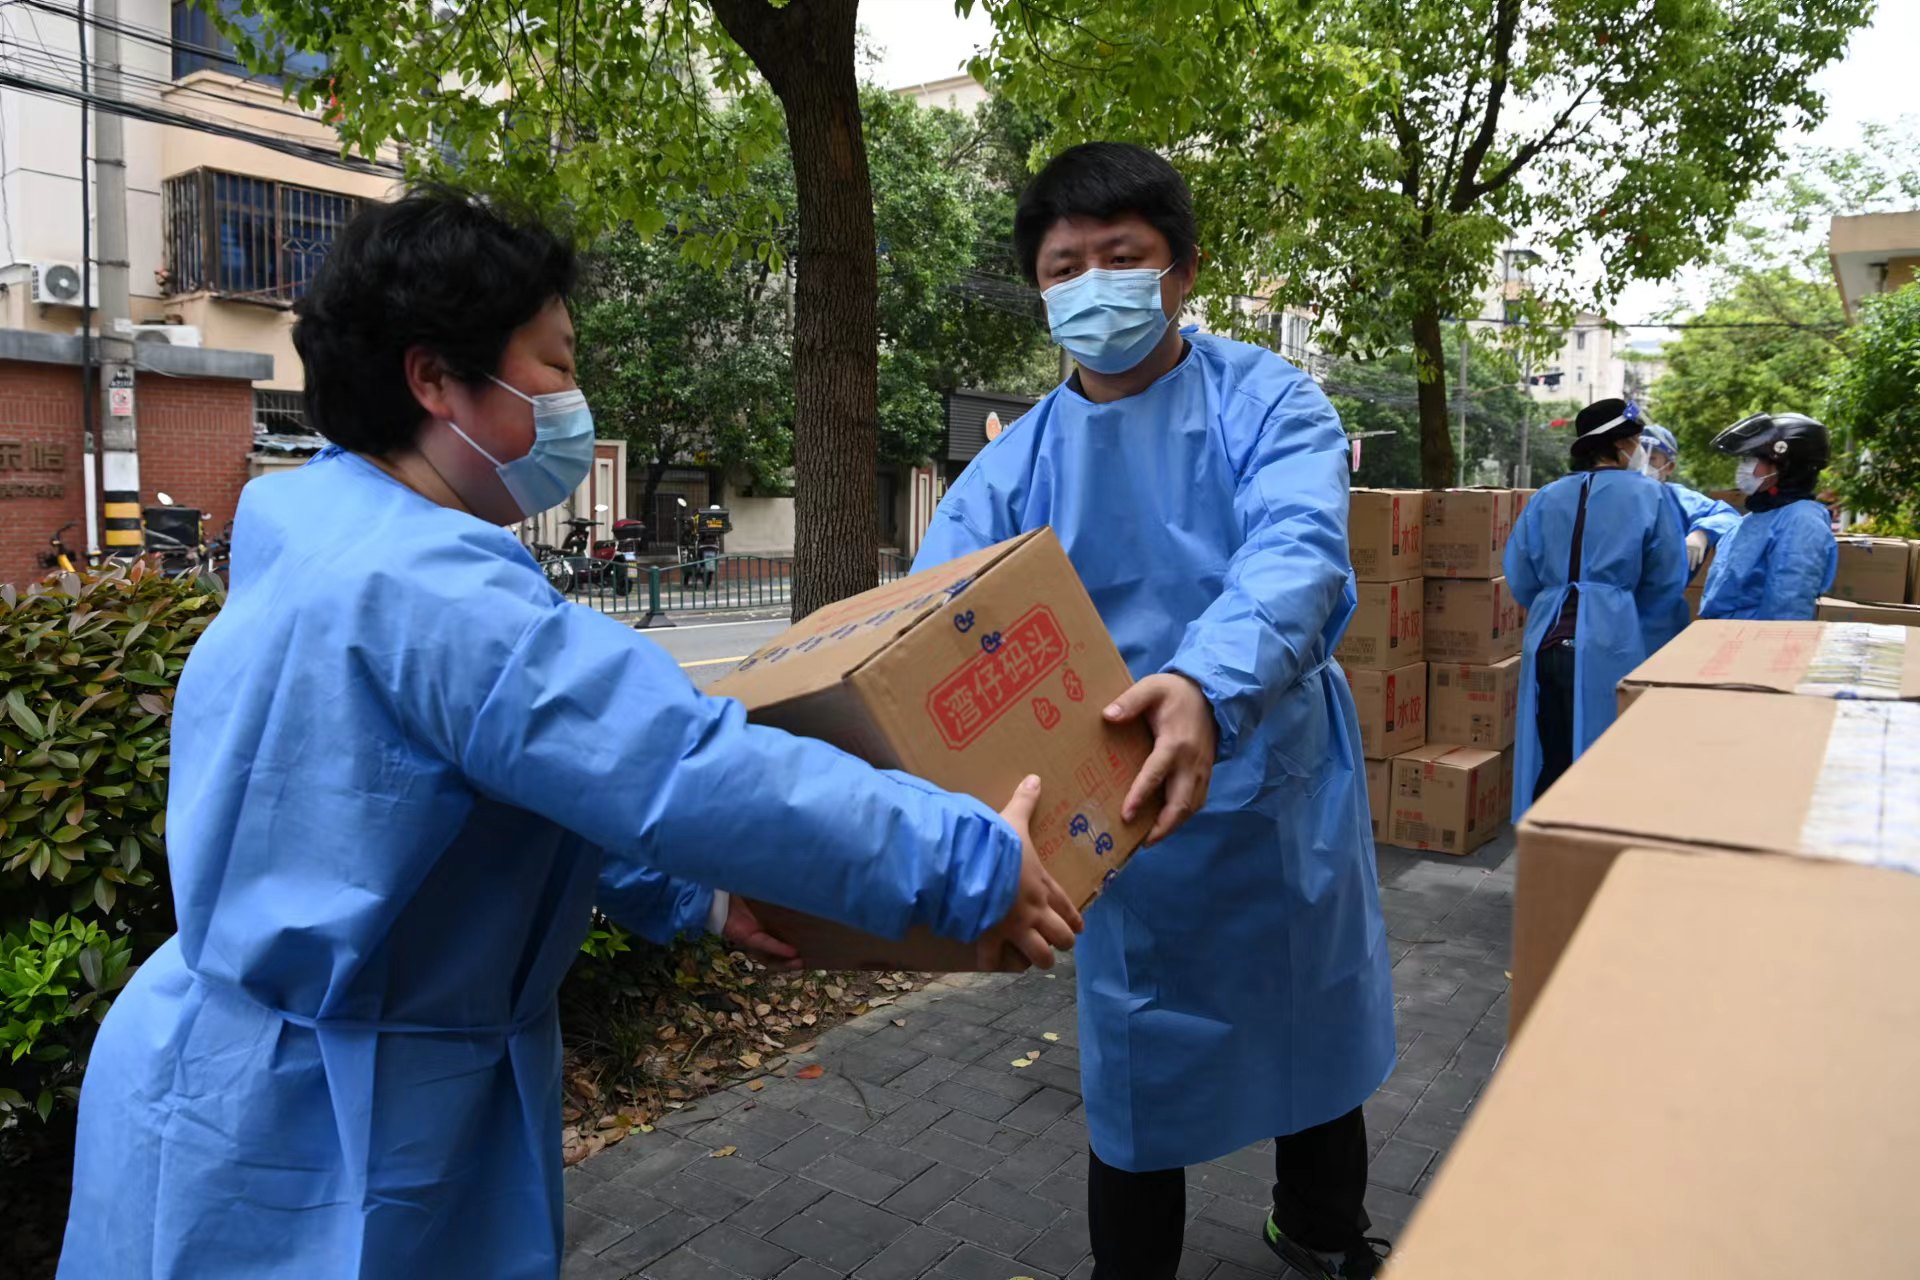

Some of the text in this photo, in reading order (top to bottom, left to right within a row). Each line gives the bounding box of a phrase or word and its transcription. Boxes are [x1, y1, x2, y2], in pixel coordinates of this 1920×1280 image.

[941, 622, 1060, 737] 湾仔码头
[1397, 695, 1422, 730] 水饺
